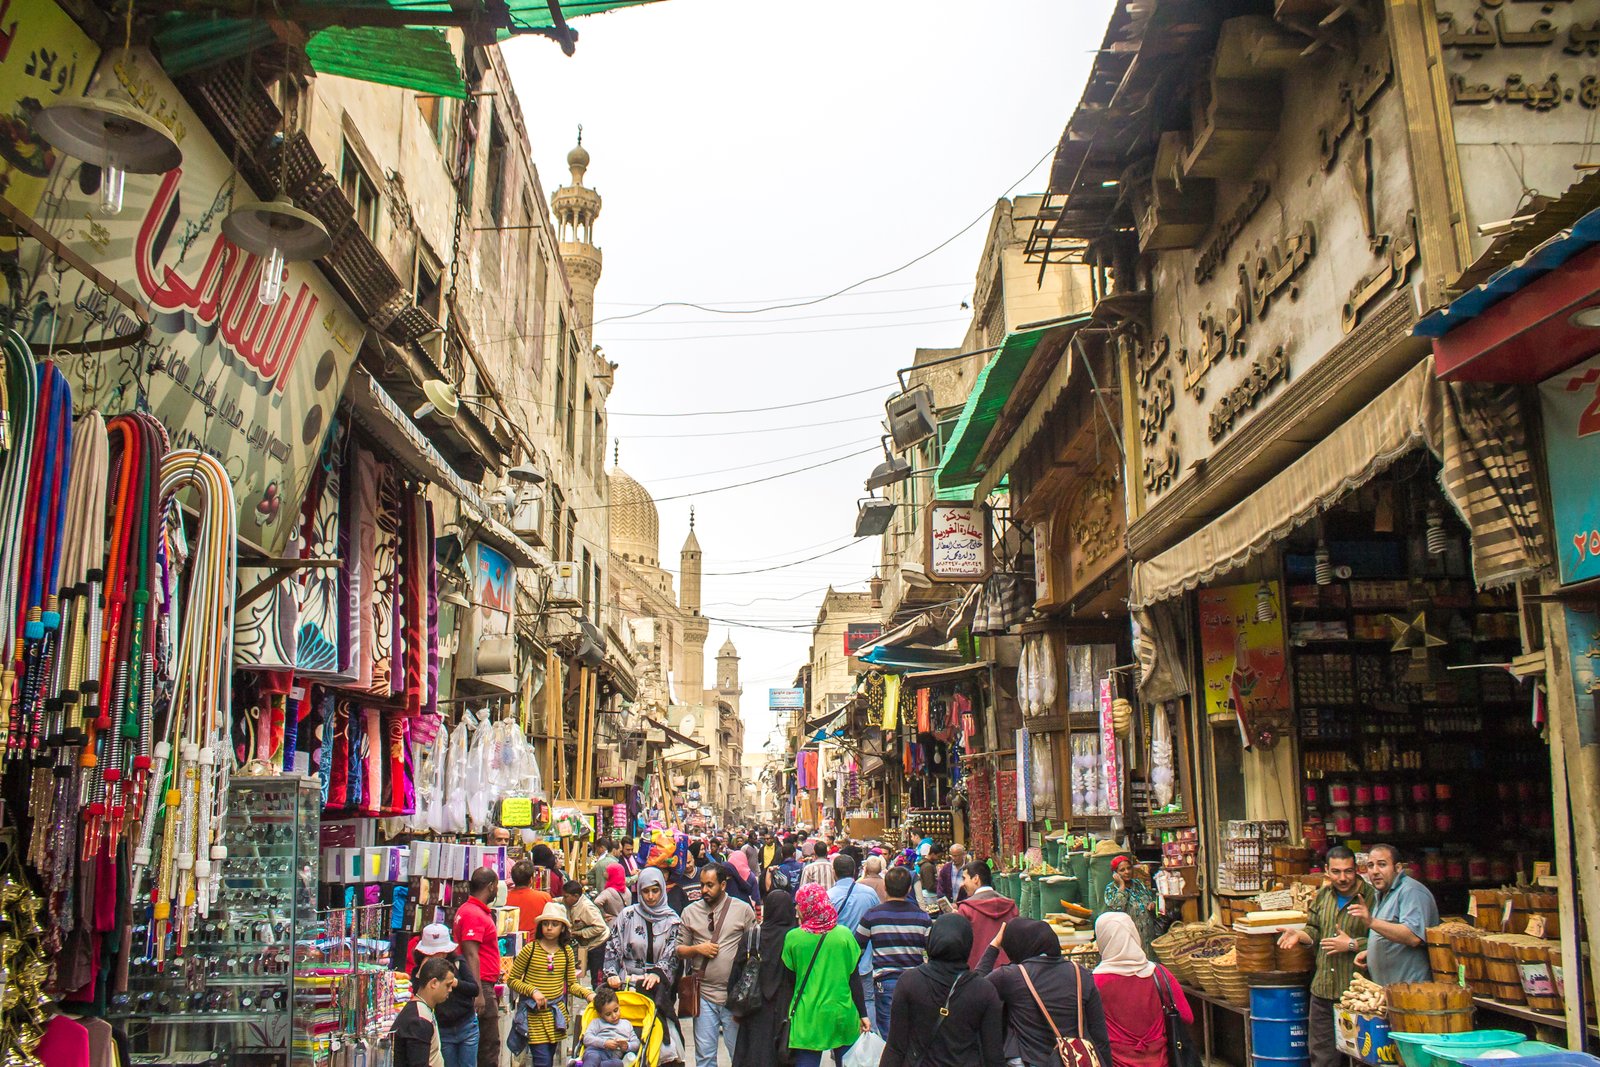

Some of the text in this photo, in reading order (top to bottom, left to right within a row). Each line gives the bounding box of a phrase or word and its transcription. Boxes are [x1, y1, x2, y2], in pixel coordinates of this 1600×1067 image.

[943, 509, 971, 522] شركة
[933, 522, 983, 541] عطارة الغورية
